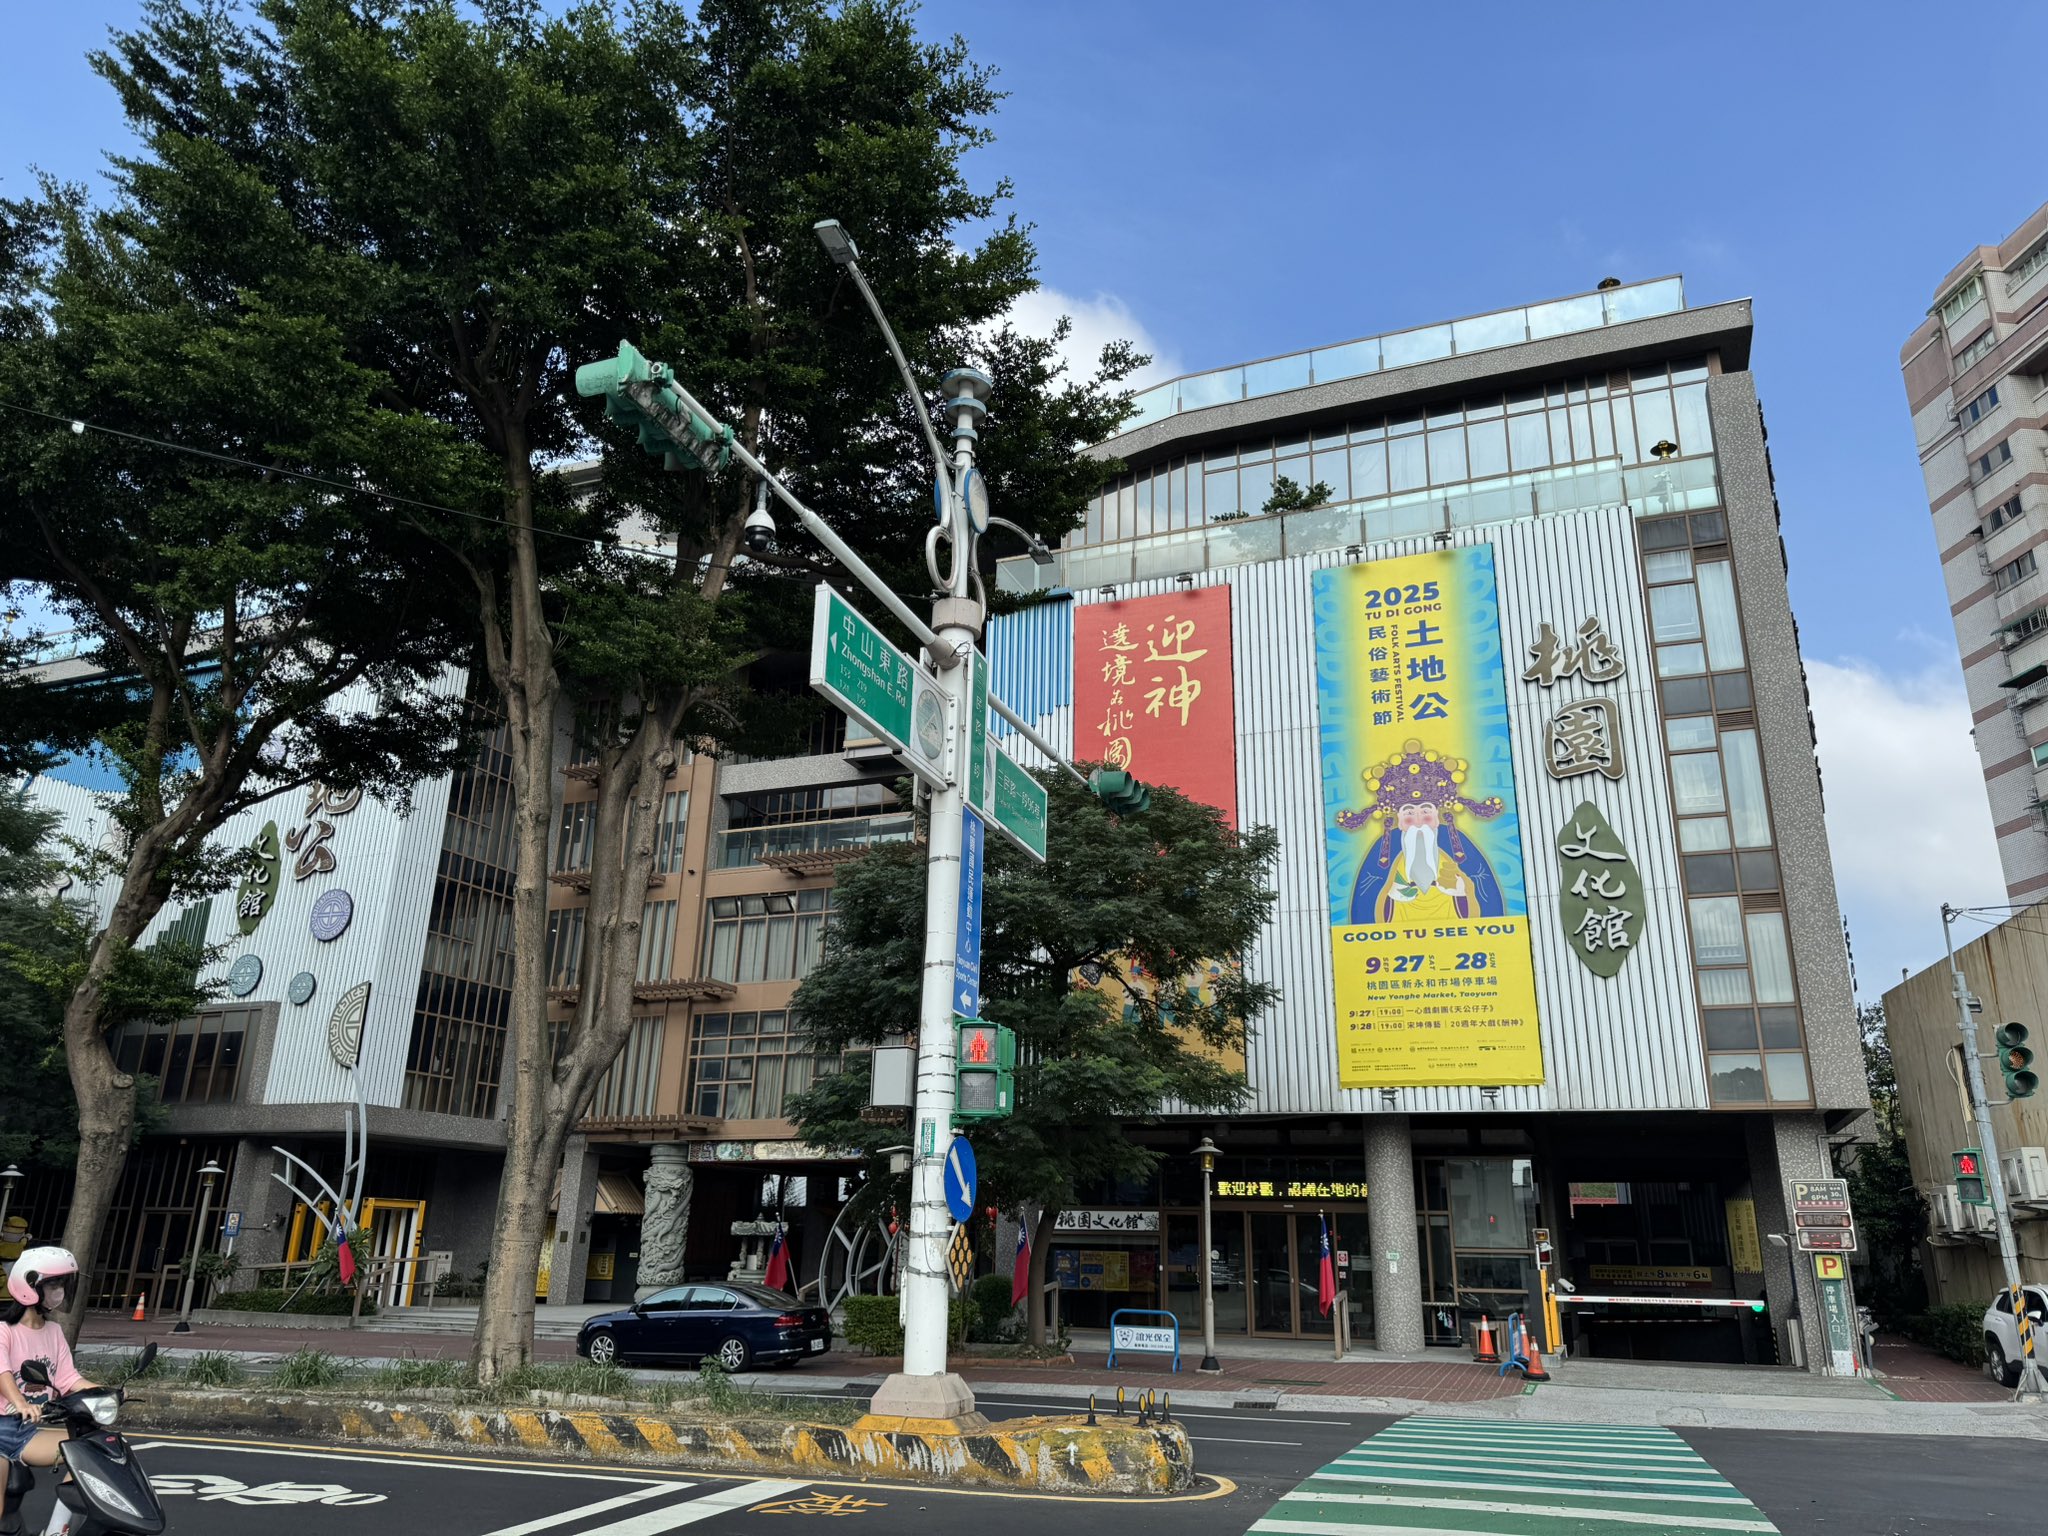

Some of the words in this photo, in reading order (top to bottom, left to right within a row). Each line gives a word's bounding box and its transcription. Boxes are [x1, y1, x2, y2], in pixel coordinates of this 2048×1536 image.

[1364, 581, 1440, 609] 2025
[1365, 611, 1382, 620] TU
[1386, 609, 1399, 618] DI
[1404, 603, 1442, 615] GONG
[1391, 624, 1399, 648] FOLK
[843, 615, 909, 692] 中山東路
[1392, 651, 1401, 675] ARTS
[842, 641, 886, 690] Zhongshan
[895, 689, 906, 708] Rd
[1144, 615, 1208, 726] 迎神
[1368, 626, 1392, 725] 民俗藝術節
[1405, 620, 1449, 720] 土地公
[1394, 678, 1404, 723] FESTIVAL
[1522, 615, 1626, 780] 桃園
[1560, 822, 1634, 953] 文化館
[1343, 931, 1397, 942] GOOD
[1403, 929, 1427, 939] TU
[1434, 926, 1468, 938] SEE
[1475, 924, 1515, 935] YOU
[1365, 957, 1381, 974] 9
[1393, 955, 1424, 973] 27
[1455, 952, 1487, 970] 28
[1367, 976, 1497, 990] 桃園區新永和市場停車場
[1795, 1184, 1808, 1201] P
[1058, 1211, 1141, 1229] 桃園文化館
[1822, 1257, 1838, 1275] P
[1825, 1285, 1840, 1332] 停車場入口
